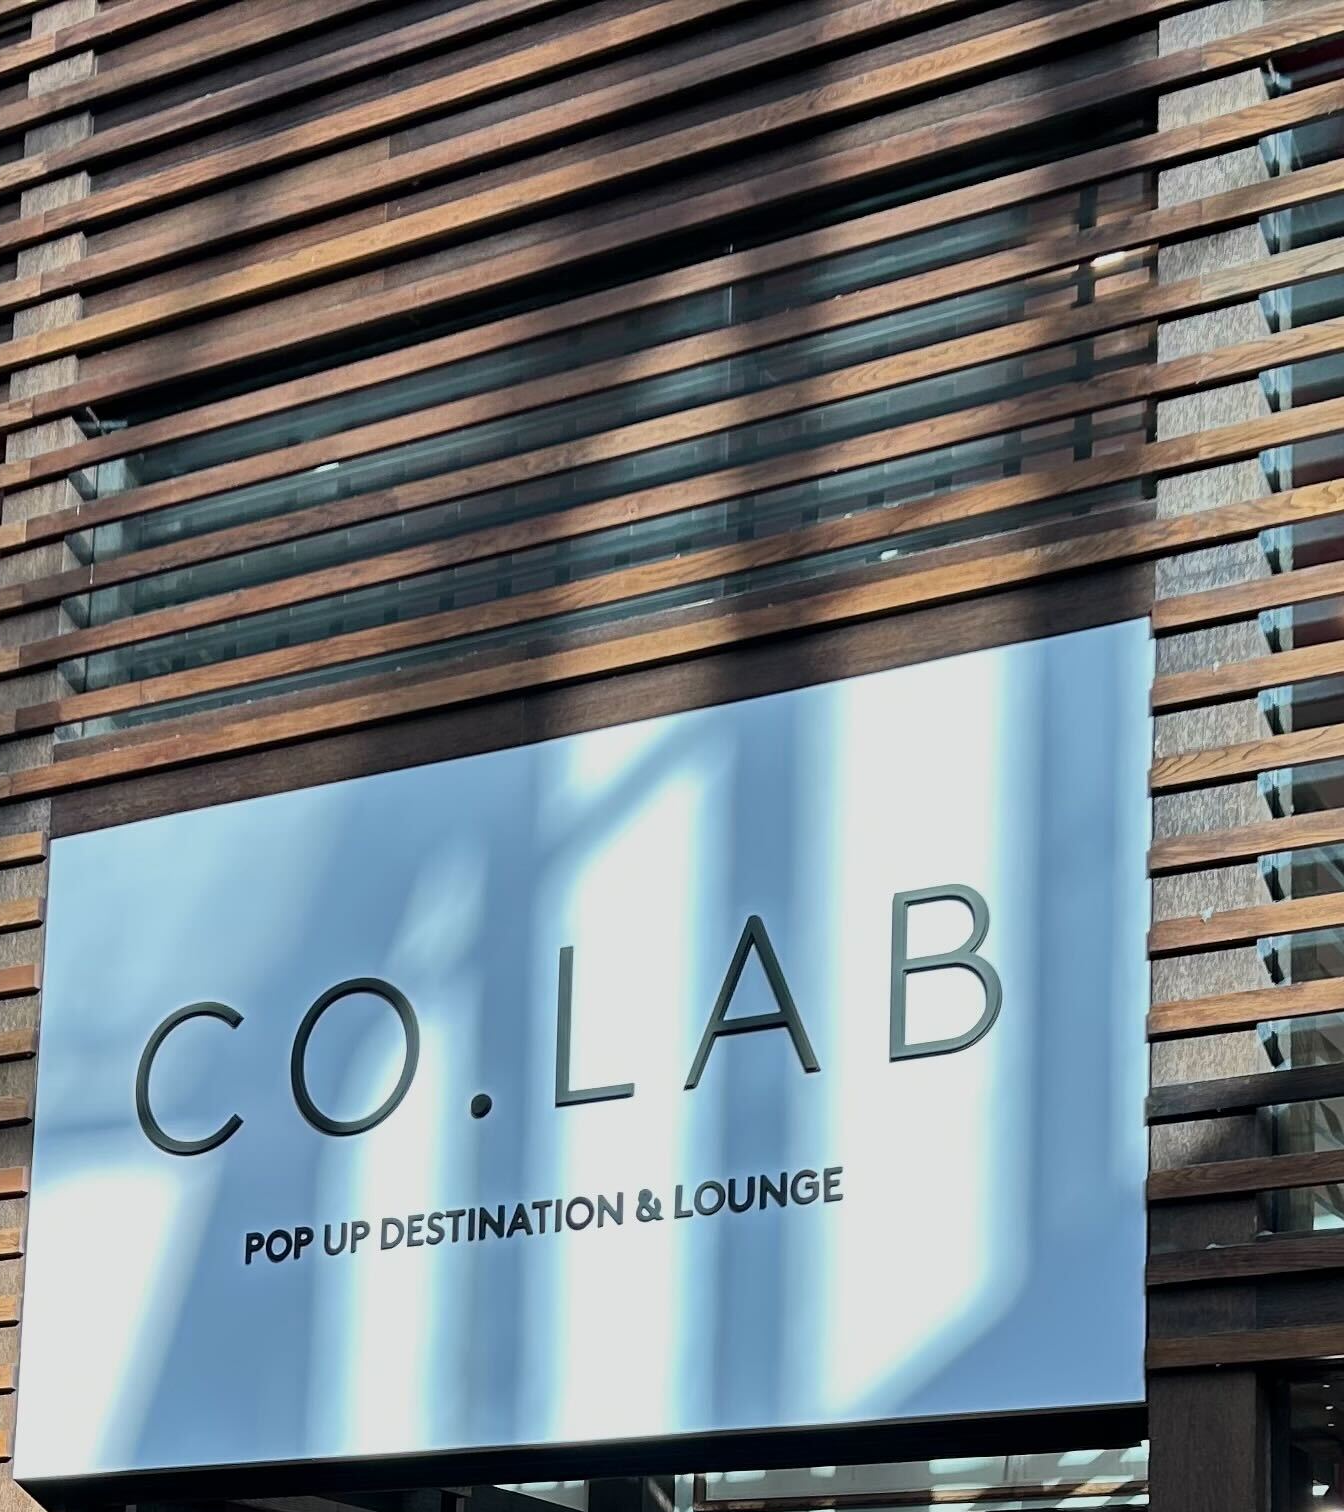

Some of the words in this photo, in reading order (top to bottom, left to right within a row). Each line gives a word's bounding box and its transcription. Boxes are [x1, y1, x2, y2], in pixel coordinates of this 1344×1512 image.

[135, 884, 1003, 1156] CO.LAB
[243, 1226, 315, 1265] POP
[322, 1220, 371, 1257] UP
[380, 1190, 623, 1250] DESTINATION
[636, 1188, 663, 1223] &
[673, 1166, 844, 1219] LOUNGE
